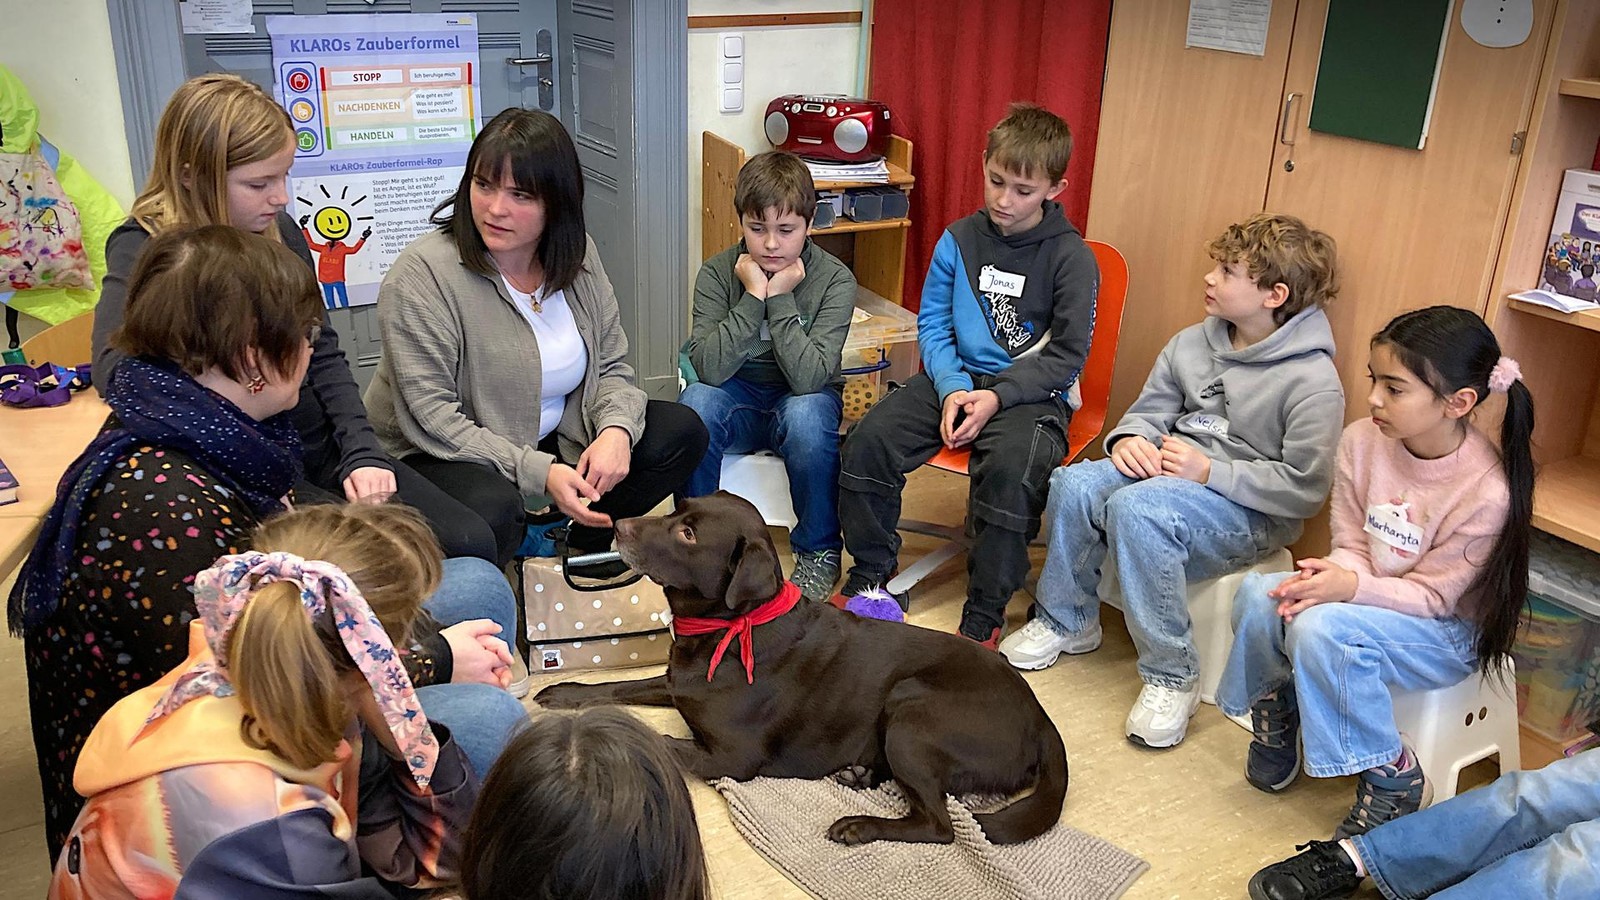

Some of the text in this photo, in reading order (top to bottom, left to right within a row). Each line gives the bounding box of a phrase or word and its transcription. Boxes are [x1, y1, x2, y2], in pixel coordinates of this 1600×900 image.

[290, 35, 460, 53] KLAROs Zauberformel
[353, 72, 382, 82] STOPP
[338, 101, 400, 112] NACHDENKEN
[350, 131, 394, 141] HANDELN
[330, 158, 442, 172] KLAROs Zauberformel-Rap
[985, 274, 1015, 290] Jonas
[1194, 416, 1226, 434] Nels
